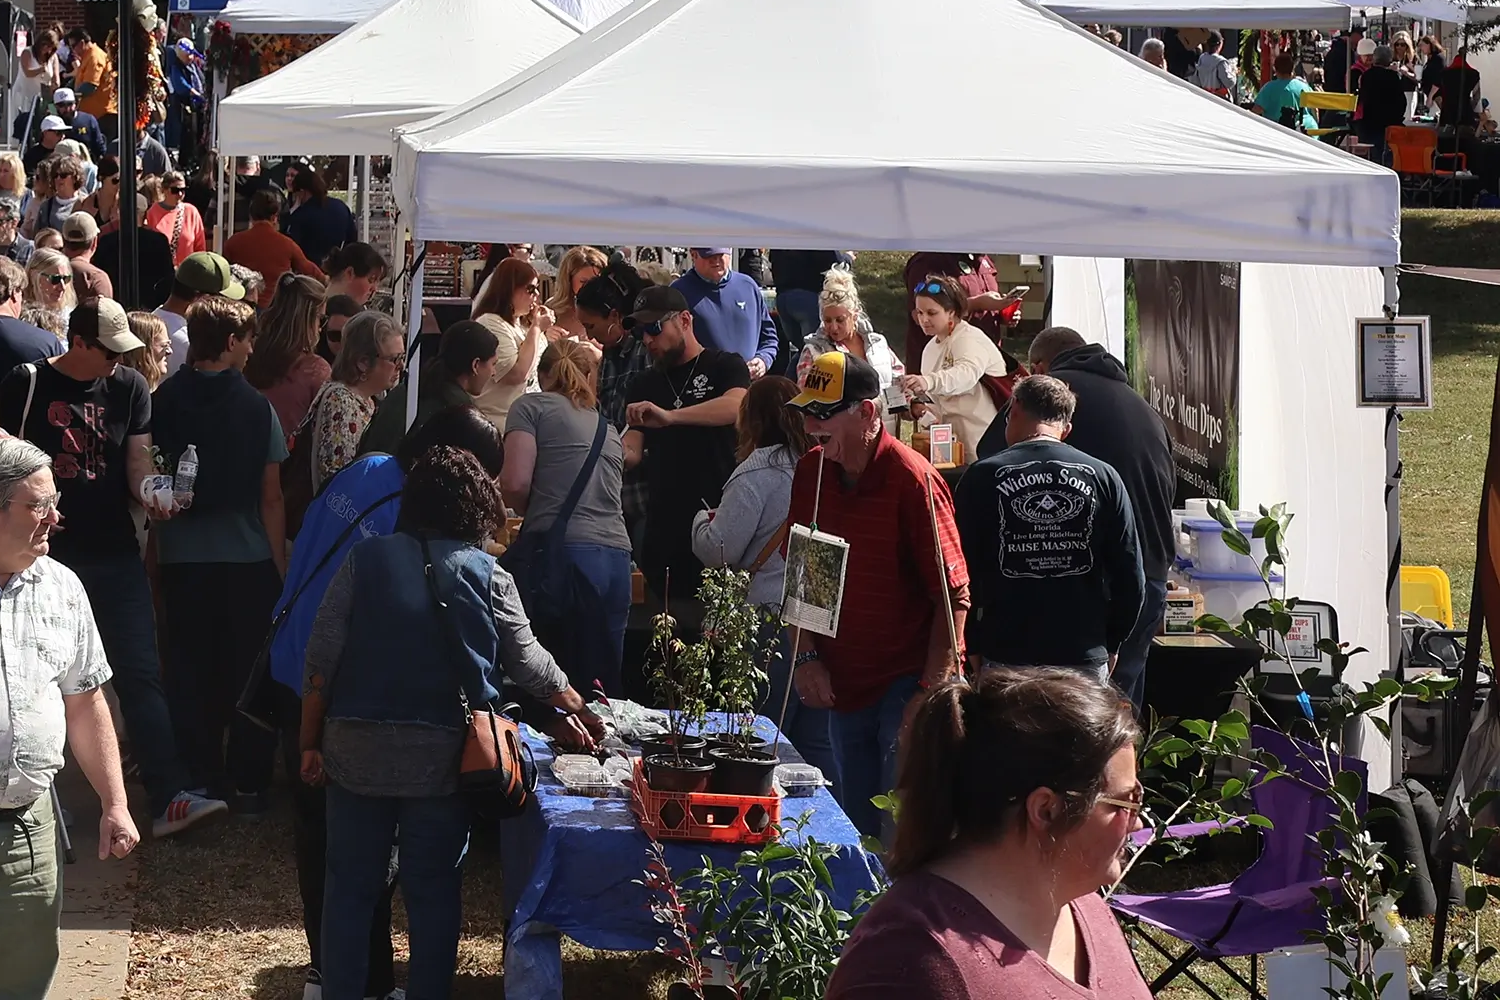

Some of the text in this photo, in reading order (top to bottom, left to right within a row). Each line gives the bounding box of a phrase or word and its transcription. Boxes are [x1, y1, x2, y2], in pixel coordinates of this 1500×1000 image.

[804, 373, 832, 392] RMY
[1149, 375, 1222, 448] The Ice Man Dips
[996, 468, 1093, 497] Widows Sons
[1028, 508, 1040, 518] Old
[1034, 524, 1061, 532] Florida
[1008, 540, 1087, 553] RAISE MASONS
